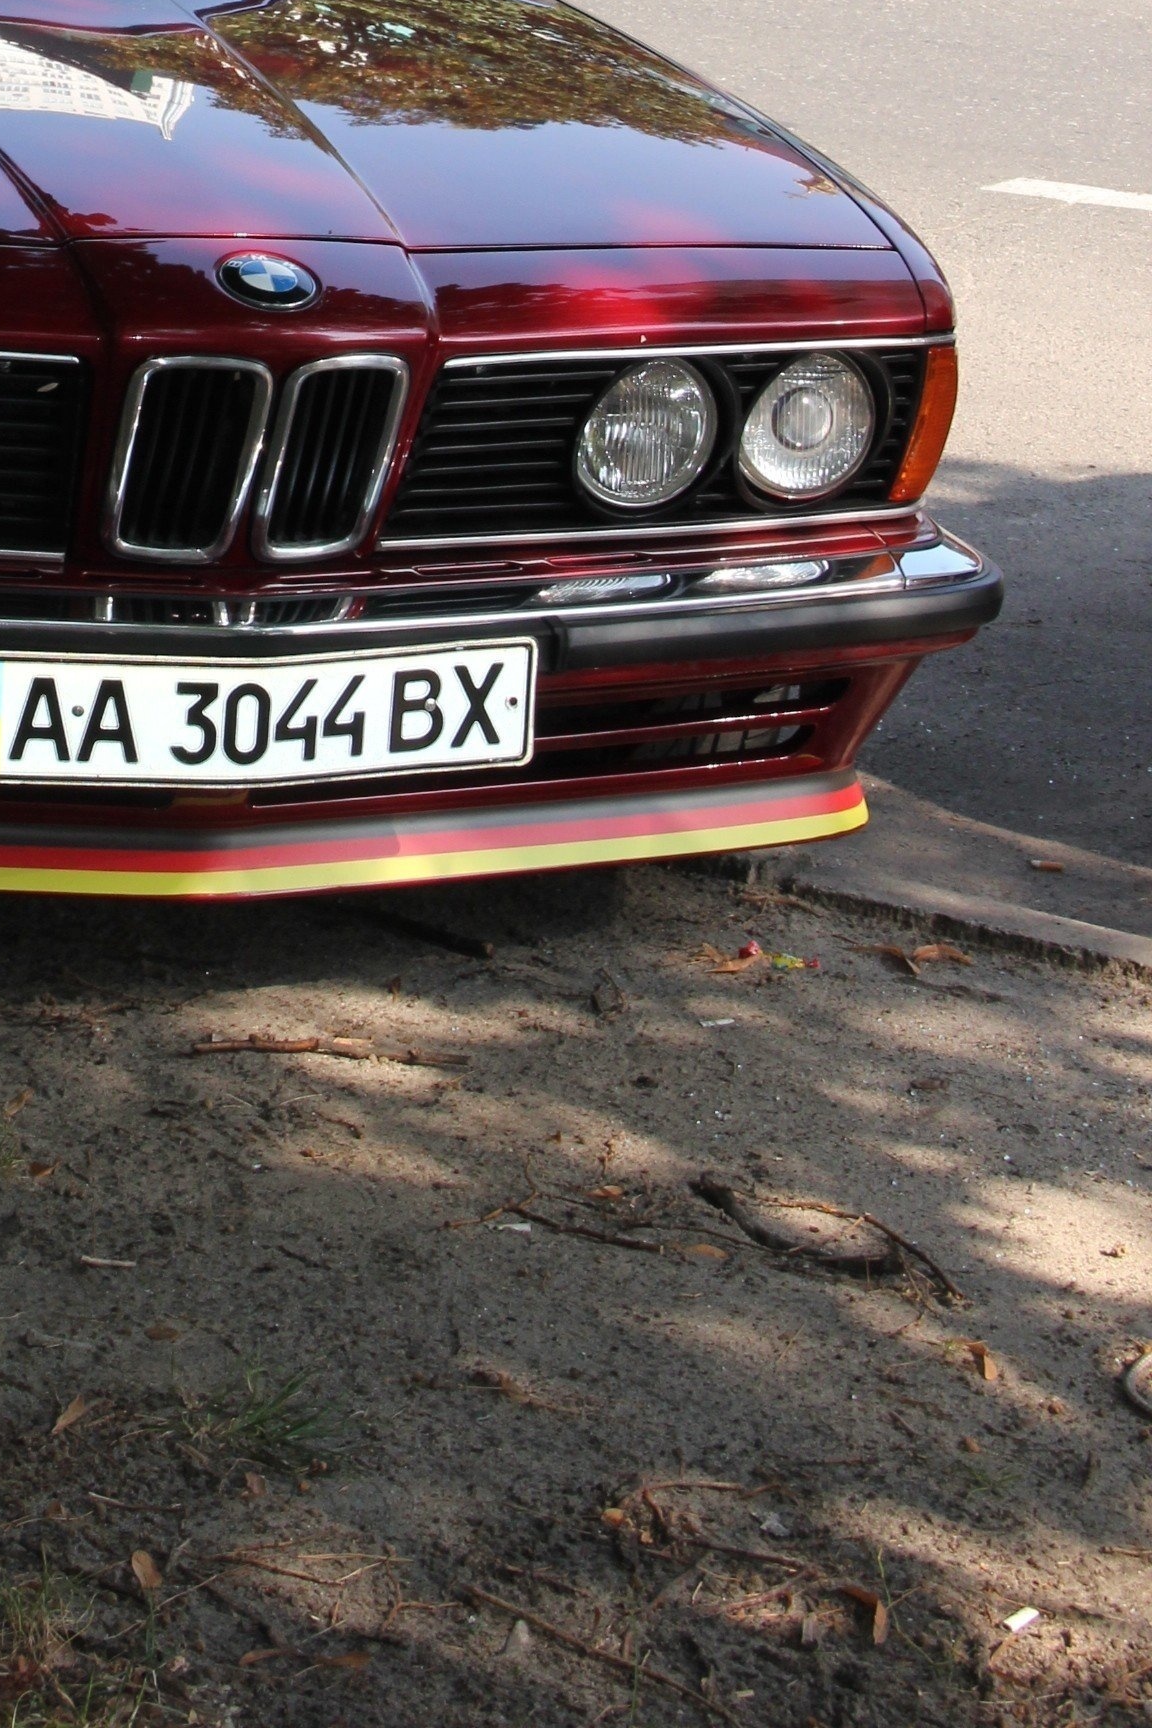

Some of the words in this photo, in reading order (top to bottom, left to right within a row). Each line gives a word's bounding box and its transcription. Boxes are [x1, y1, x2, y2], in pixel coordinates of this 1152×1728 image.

[8, 676, 139, 764] AA
[169, 674, 367, 765] 3044
[388, 661, 505, 754] BX
